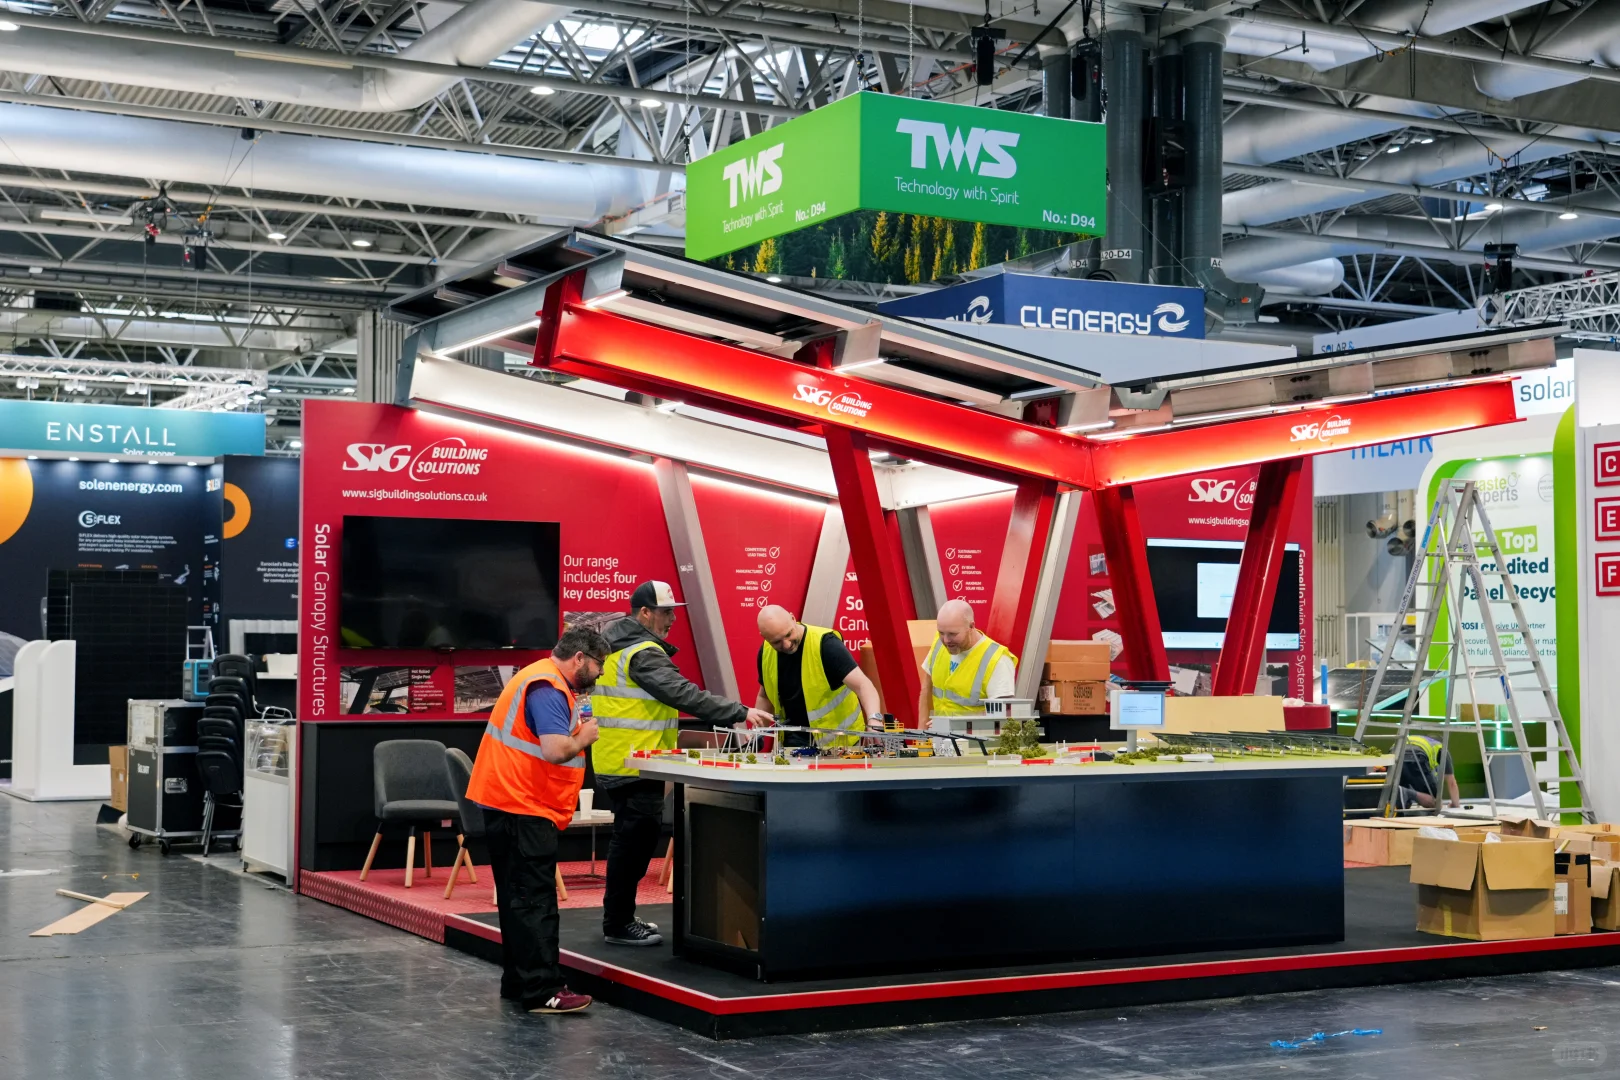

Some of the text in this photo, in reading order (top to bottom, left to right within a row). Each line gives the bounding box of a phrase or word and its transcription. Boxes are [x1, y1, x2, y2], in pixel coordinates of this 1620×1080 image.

[895, 118, 1020, 179] TWS
[722, 142, 785, 209] TWS
[894, 176, 1020, 205] Technology with Spirit
[722, 200, 784, 234] Technology with Spirit
[795, 201, 826, 222] No.: D94
[1042, 209, 1096, 229] No.: D94
[1020, 305, 1151, 335] CLENERGY
[1321, 342, 1347, 353] SOLAR
[793, 384, 832, 406] SIG
[841, 395, 872, 410] BUILDING
[832, 402, 867, 417] SOLUTIONS
[1290, 422, 1319, 442] SIG
[1321, 427, 1349, 437] SOLUTIONS
[1327, 418, 1351, 428] BUILDING
[46, 421, 177, 447] ENSTALL
[342, 443, 411, 472] SIG
[431, 446, 488, 461] BUILDING
[416, 461, 481, 475] SOLUTIONS
[1605, 455, 1617, 473] C
[79, 479, 183, 494] solenenergy.com
[342, 488, 488, 502] www.sigbuildingsolutions.co.uk
[1188, 478, 1236, 503] SIG
[1480, 487, 1518, 505] perts
[1606, 510, 1617, 527] E
[1501, 531, 1536, 552] Top
[563, 554, 619, 570] Our range
[563, 571, 637, 584] includes four
[1607, 565, 1618, 583] F
[563, 587, 583, 602] key
[846, 595, 864, 611] So
[310, 523, 331, 716] Solar Canopy Structures
[545, 996, 561, 1009] N
